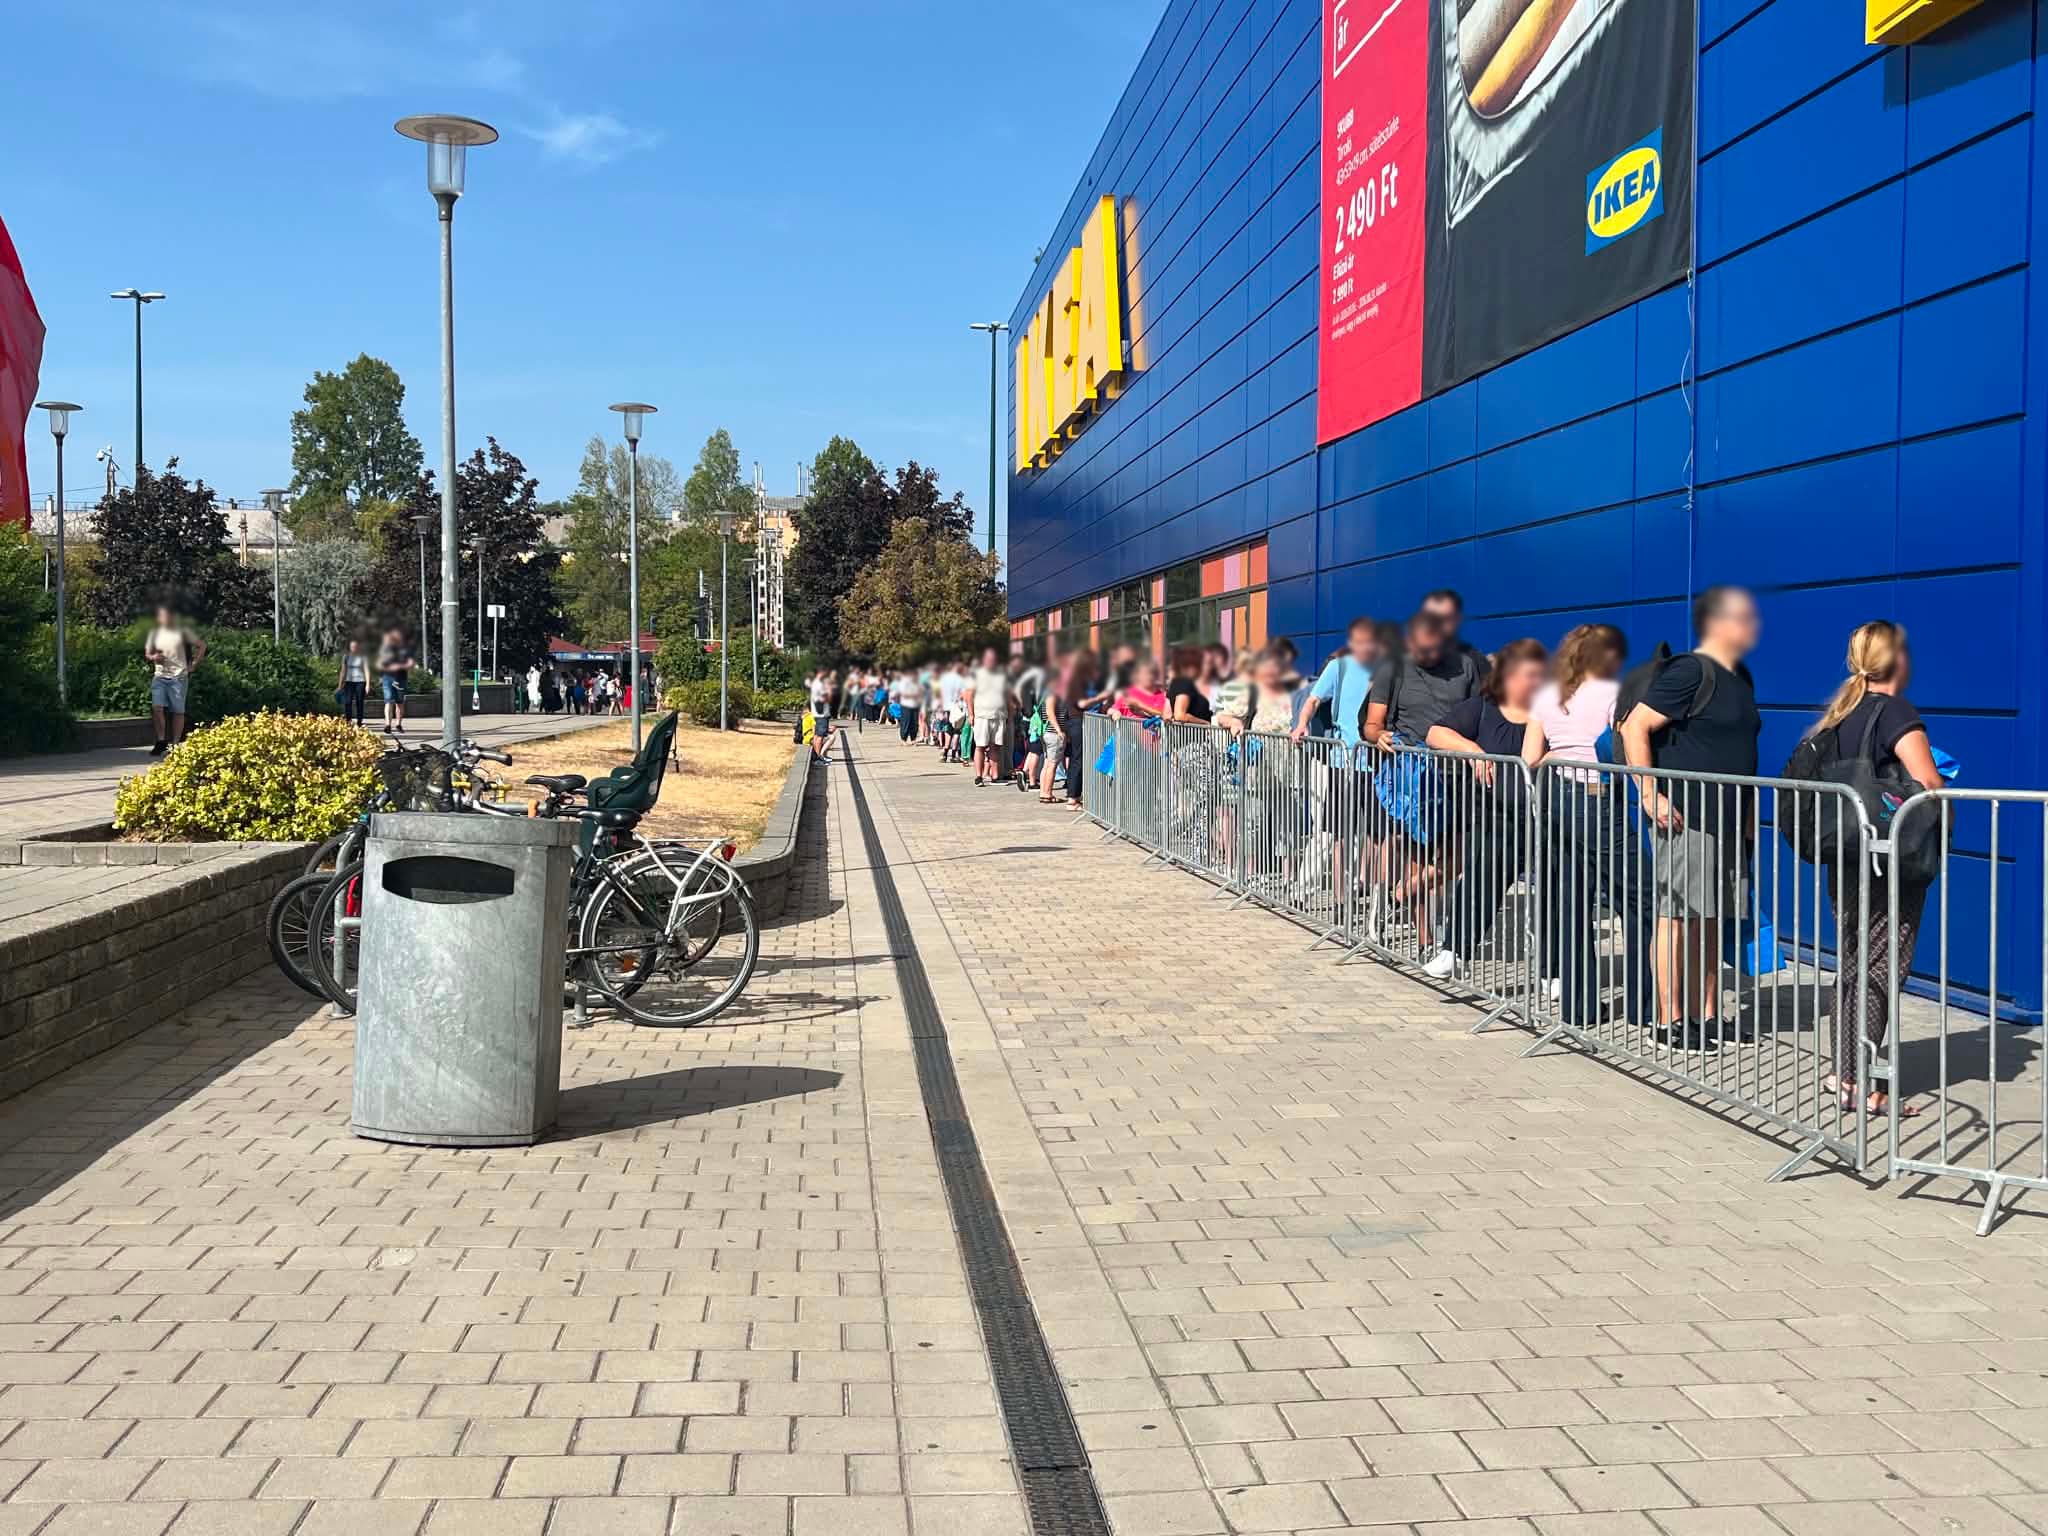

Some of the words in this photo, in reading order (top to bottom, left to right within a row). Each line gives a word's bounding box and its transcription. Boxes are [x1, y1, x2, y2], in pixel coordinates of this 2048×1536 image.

[1335, 206, 1345, 254] 2
[1346, 177, 1376, 240] 490
[1381, 162, 1398, 216] Ft
[1594, 159, 1656, 225] IKEA
[1016, 194, 1122, 475] IKEA
